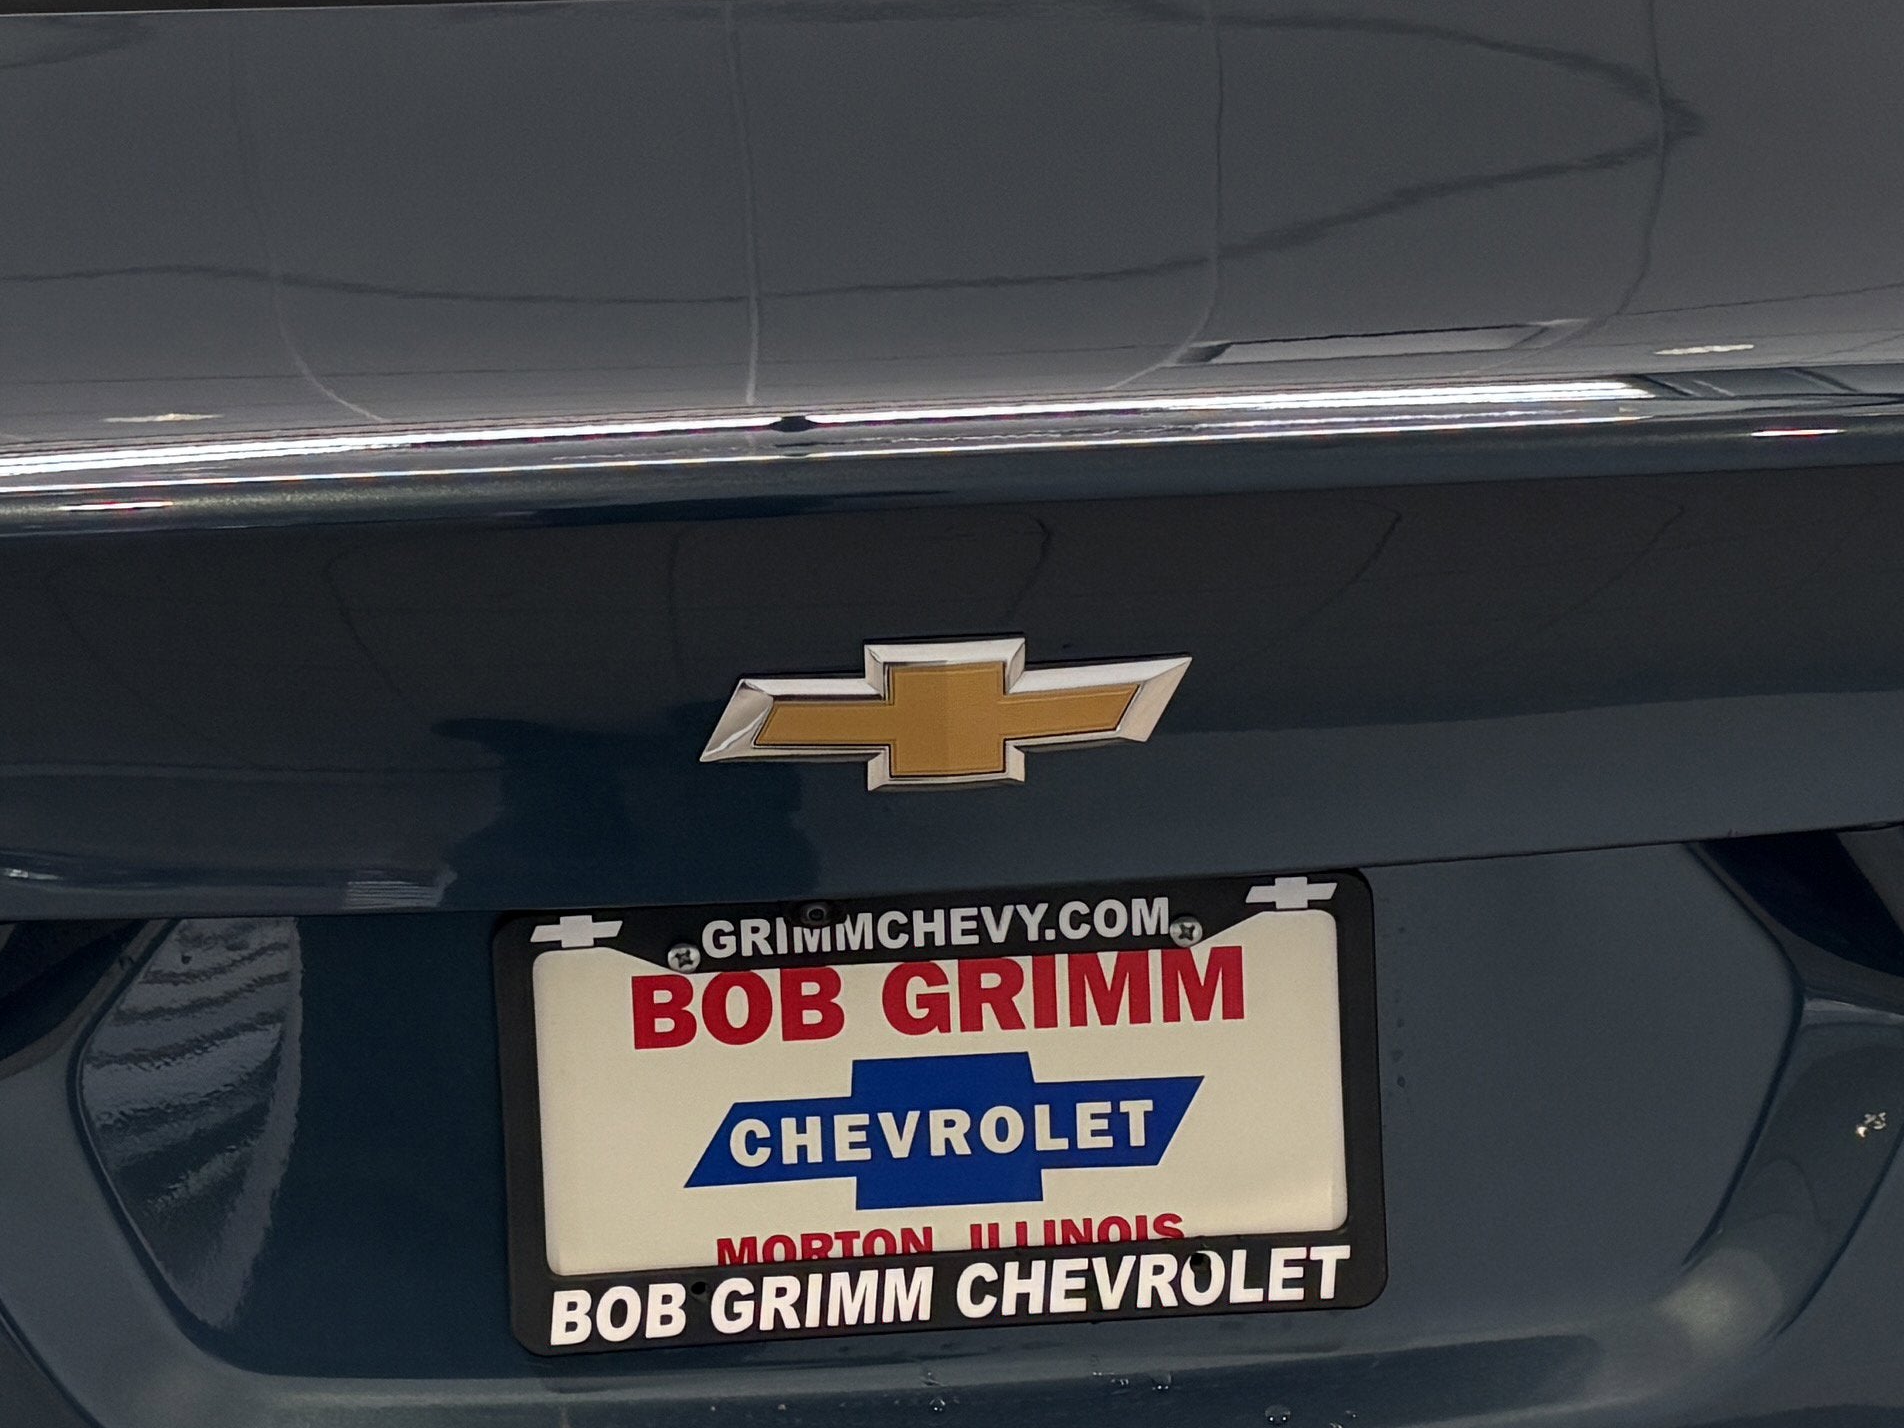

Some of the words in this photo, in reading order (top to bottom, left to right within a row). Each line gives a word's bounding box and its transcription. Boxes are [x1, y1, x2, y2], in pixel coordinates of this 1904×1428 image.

[702, 897, 1170, 959] GRIMMCHEVY.COM
[631, 965, 846, 1050] BOB
[882, 945, 1246, 1035] GRIMM
[729, 1098, 1155, 1168] CHEVROLET
[716, 1226, 934, 1267] MORTON
[969, 1212, 1185, 1251] ILLINOIS
[549, 1281, 688, 1347] BOB
[709, 1265, 933, 1333] GRIMM
[955, 1245, 1352, 1319] CHEVROLET
